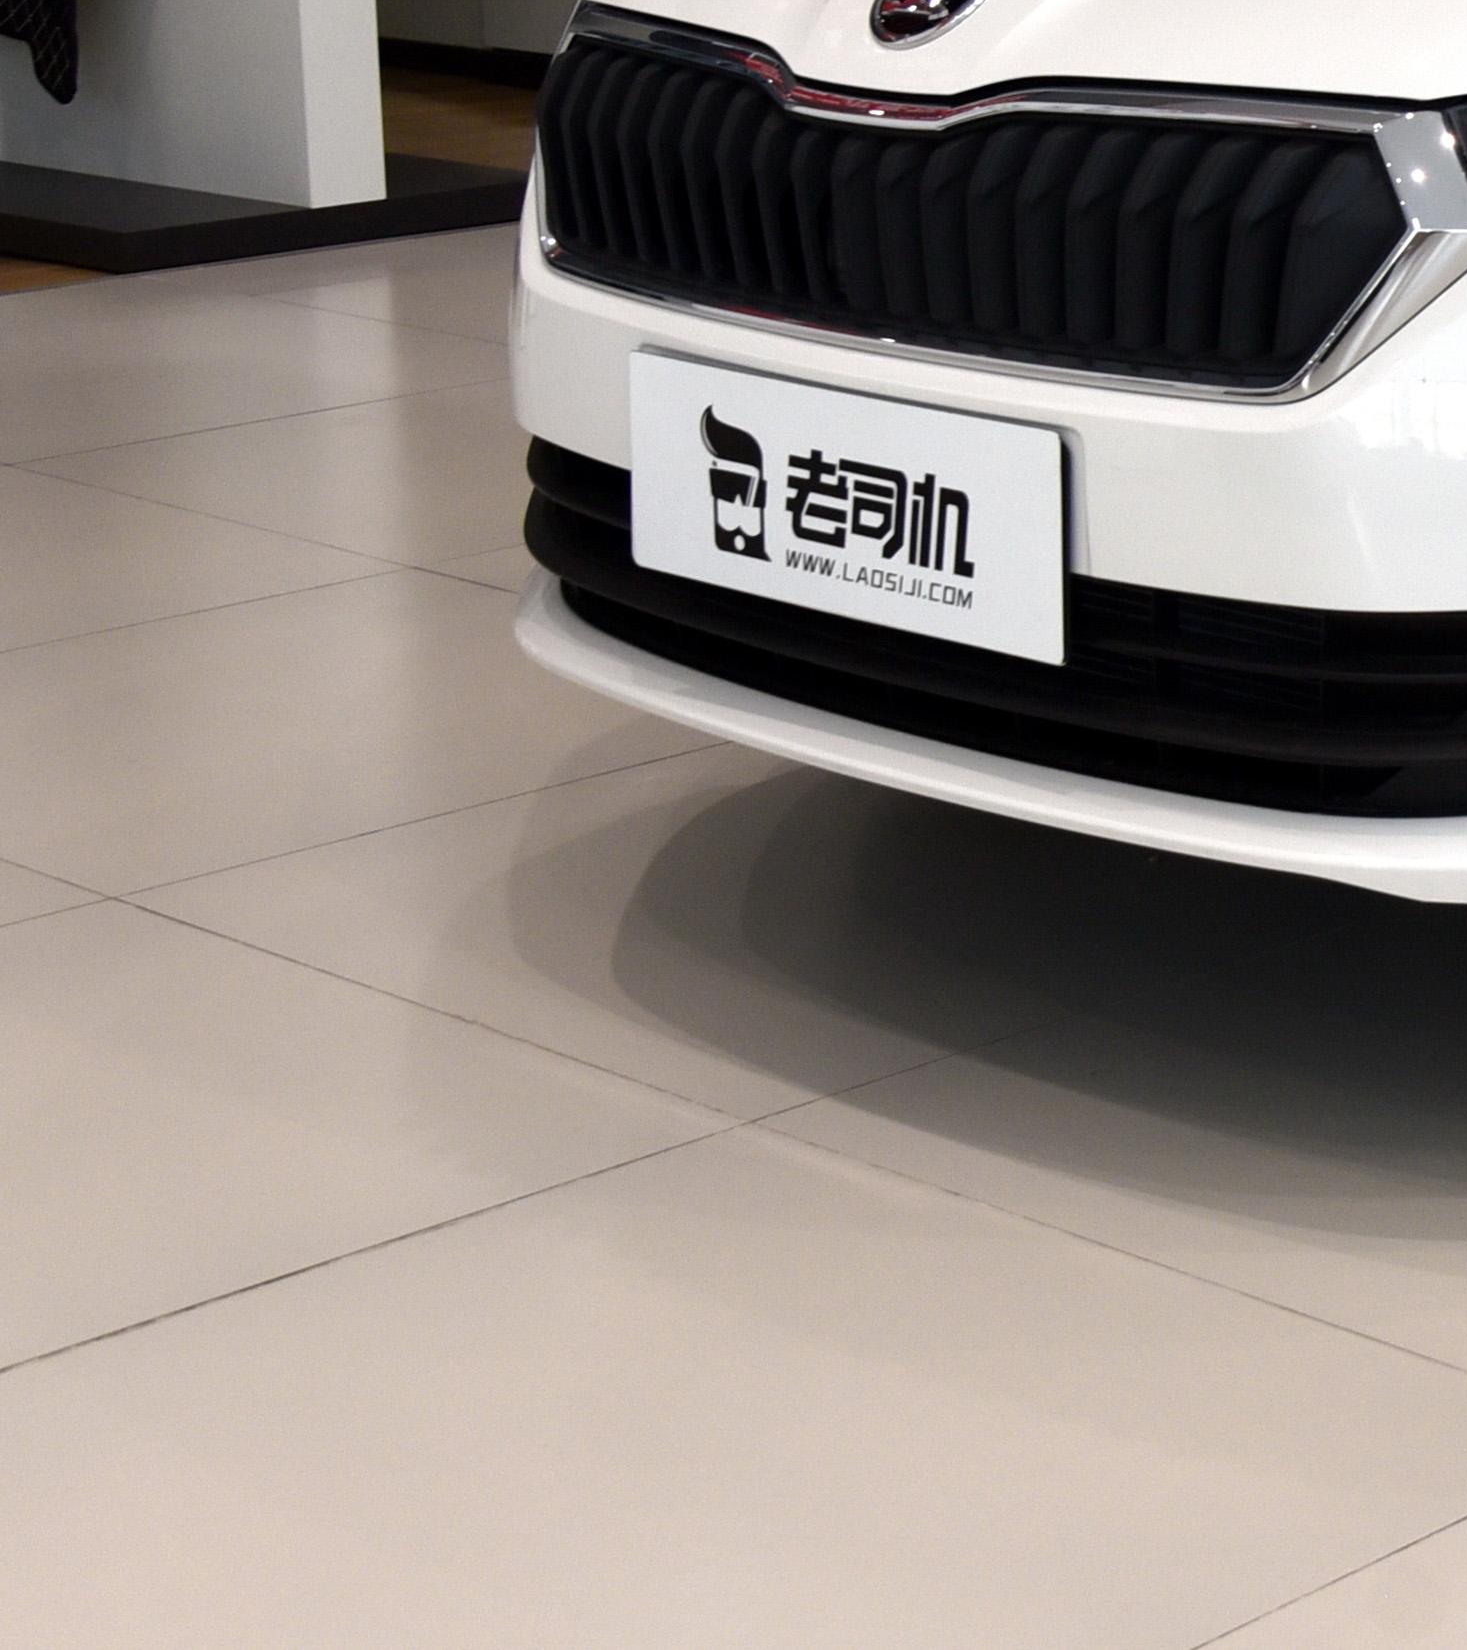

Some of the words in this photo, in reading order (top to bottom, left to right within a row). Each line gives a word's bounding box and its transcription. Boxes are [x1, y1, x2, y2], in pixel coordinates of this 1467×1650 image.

[786, 448, 974, 578] 老司机
[785, 549, 974, 610] WWW.LAOSIJI.COM
